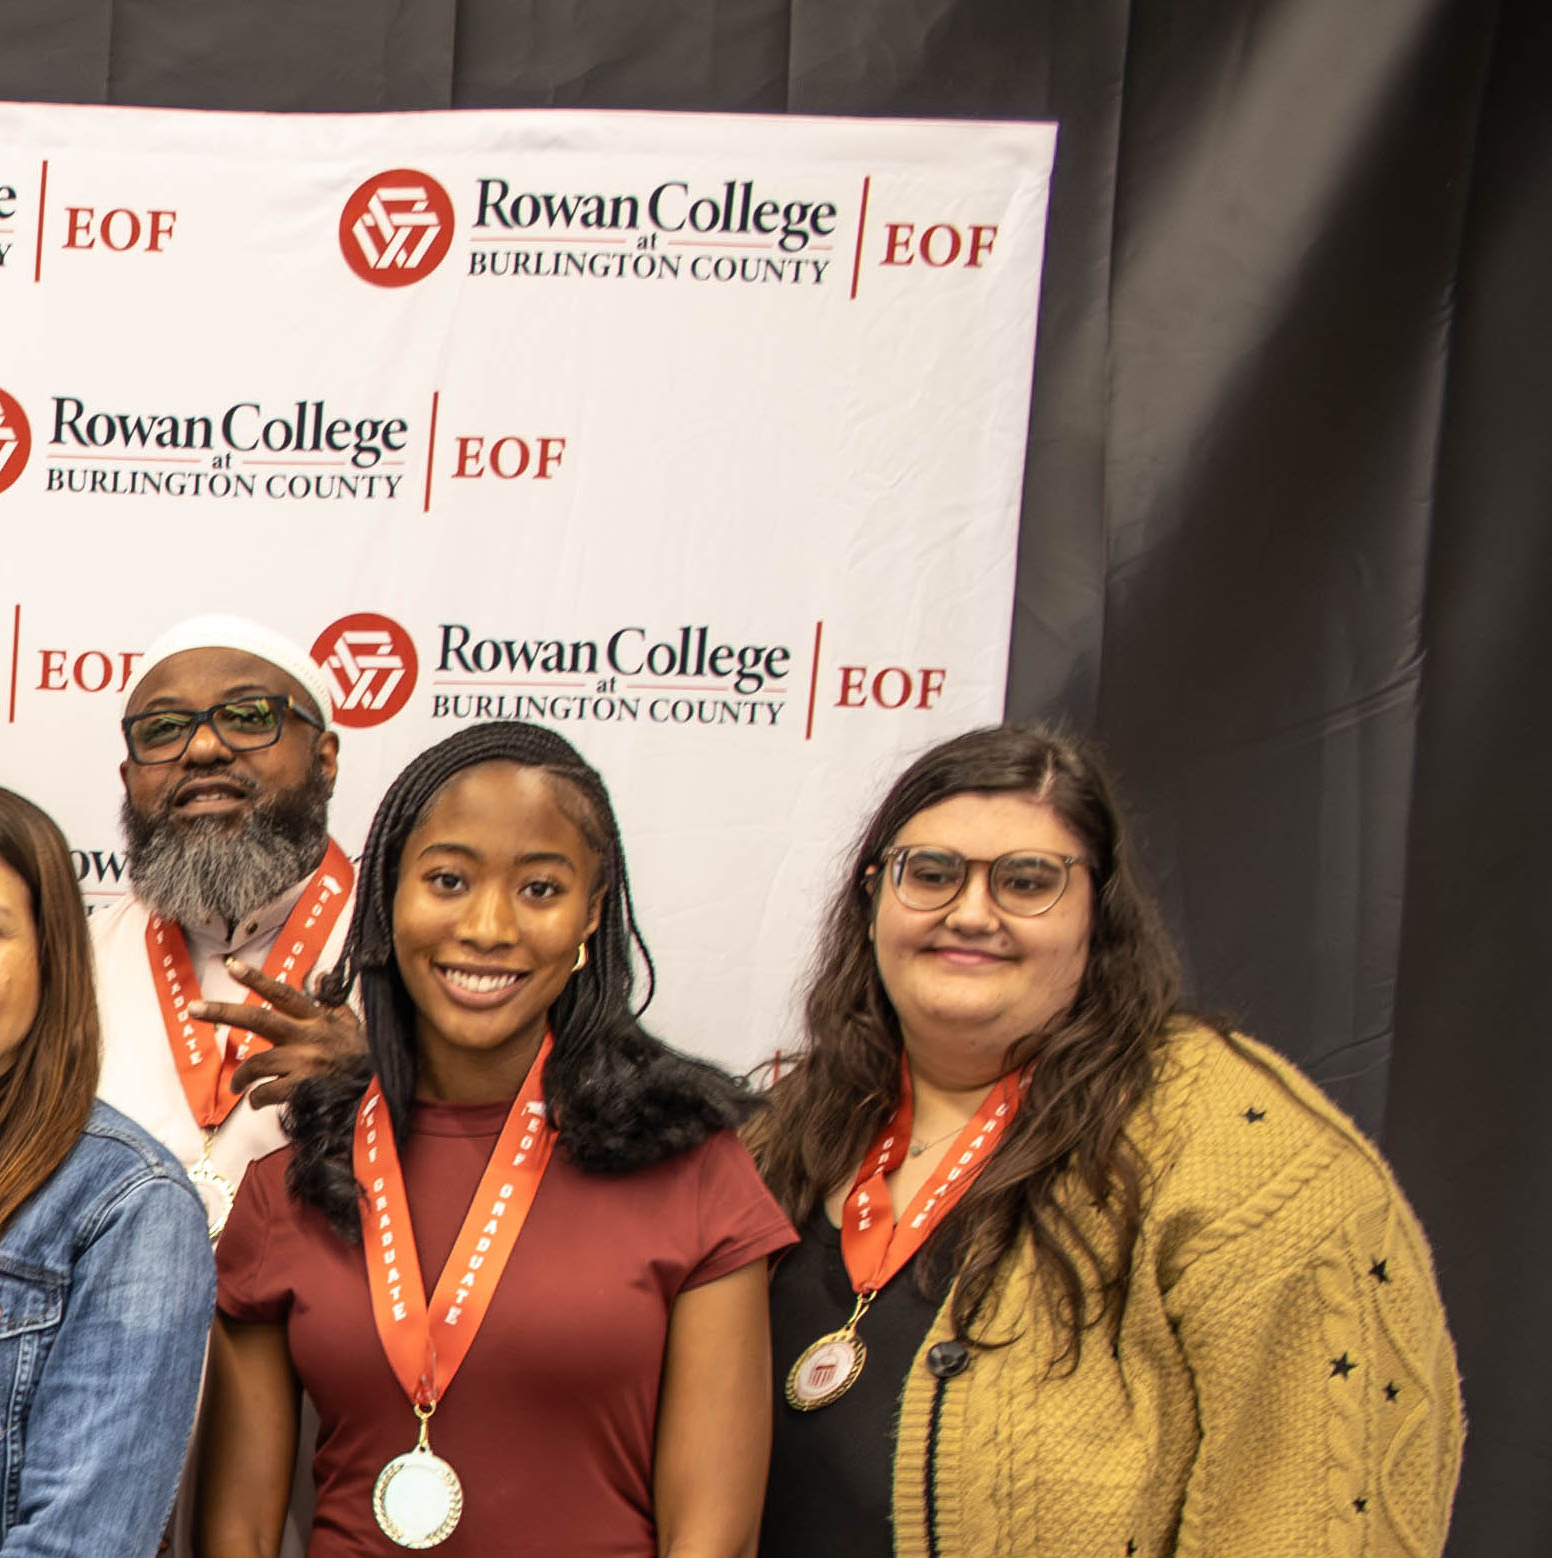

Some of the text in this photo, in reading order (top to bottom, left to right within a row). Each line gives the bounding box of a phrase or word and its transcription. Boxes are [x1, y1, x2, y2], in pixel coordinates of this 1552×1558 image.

[63, 208, 175, 252] EOF
[475, 180, 836, 242] Rowan College
[637, 233, 657, 249] at
[882, 224, 997, 267] EOF
[469, 253, 829, 283] BURLINGTON COUNTY
[50, 398, 407, 468] Rowan College
[211, 453, 232, 469] at
[453, 437, 565, 479] EOF
[47, 469, 403, 498] BURLINGTON COUNTY
[437, 625, 790, 694] Rowan College
[596, 676, 616, 693] at
[836, 667, 945, 709] EOF
[433, 696, 784, 725] BURLINGTON COUNTY
[445, 1118, 540, 1326] EOF GRADUATE
[374, 1178, 408, 1322] GRADUATE
